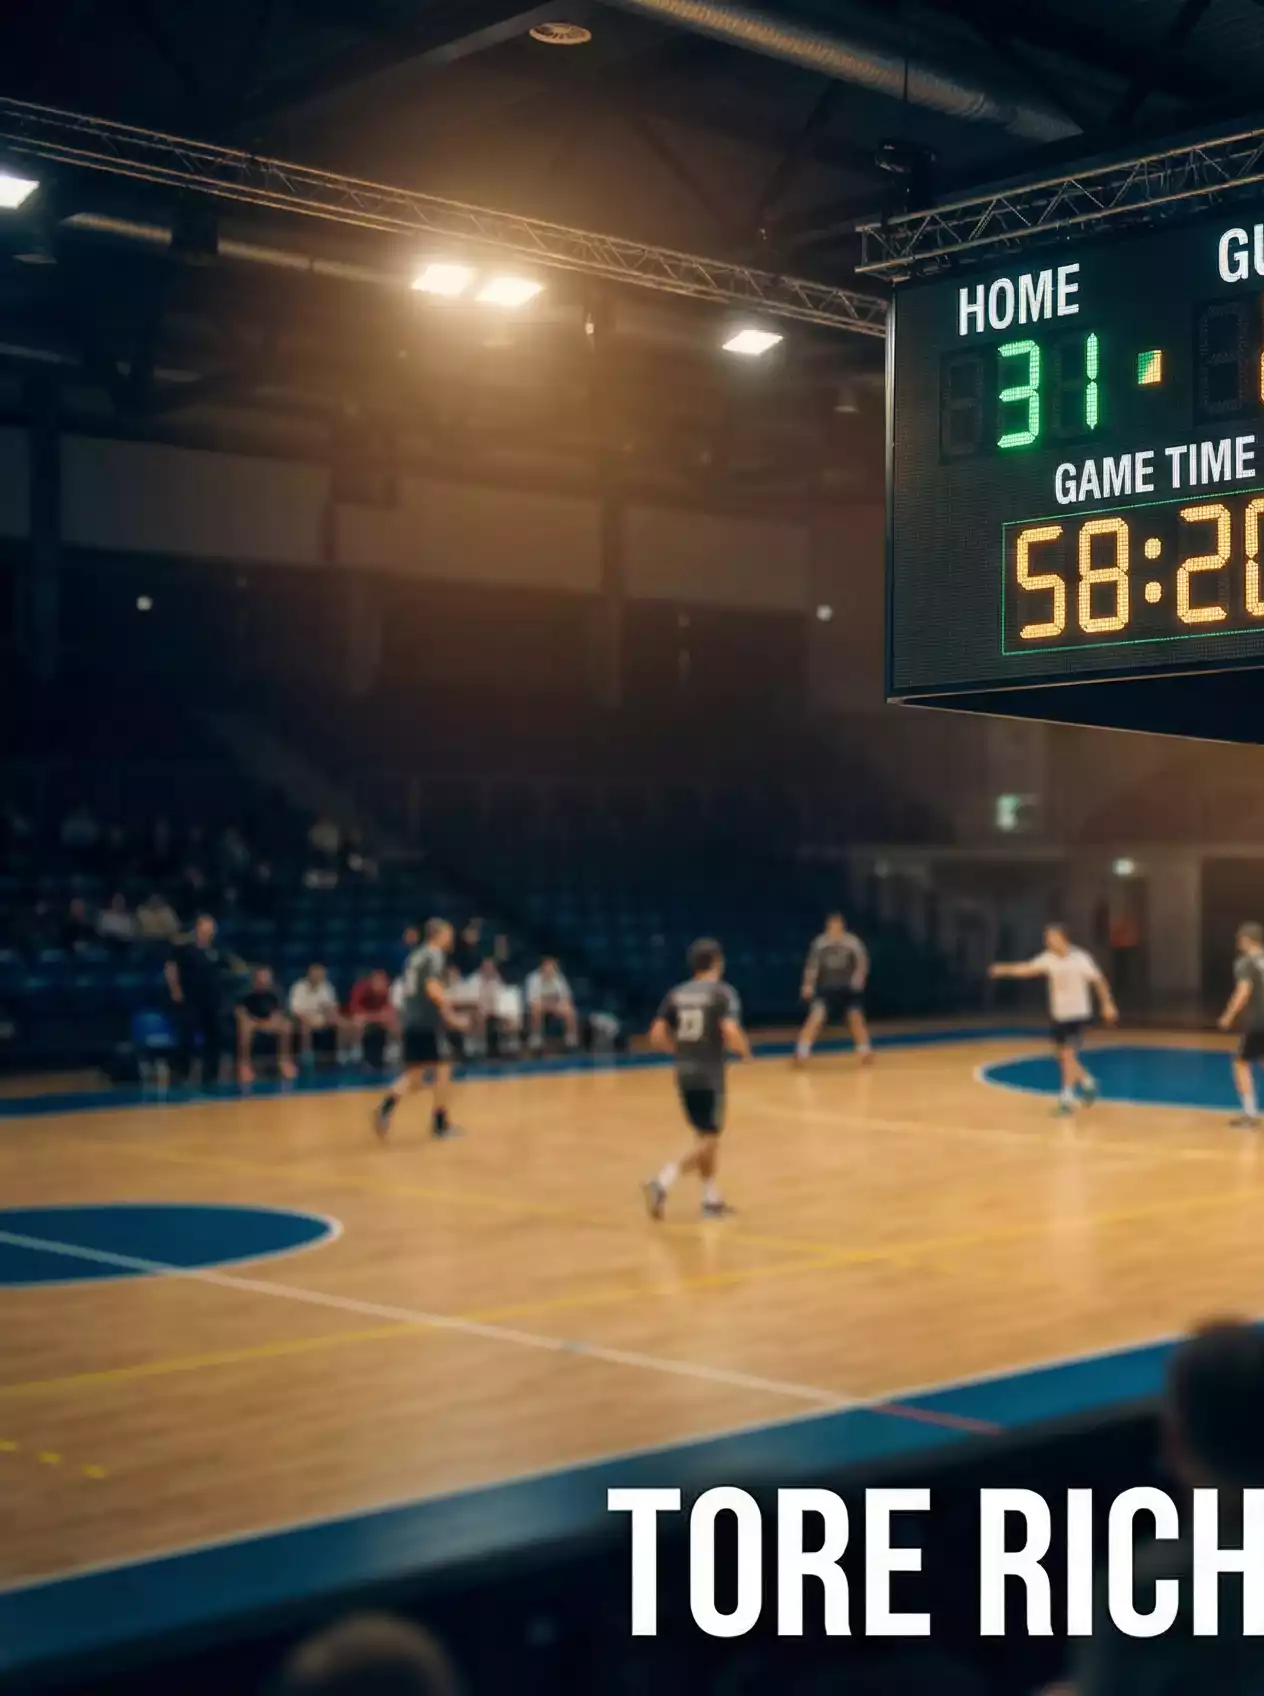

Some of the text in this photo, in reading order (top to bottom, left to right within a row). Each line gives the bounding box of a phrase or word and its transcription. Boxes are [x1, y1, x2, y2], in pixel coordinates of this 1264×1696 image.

[958, 263, 1080, 335] HOME
[997, 332, 1099, 449] 31
[1054, 434, 1257, 505] GAME TIME
